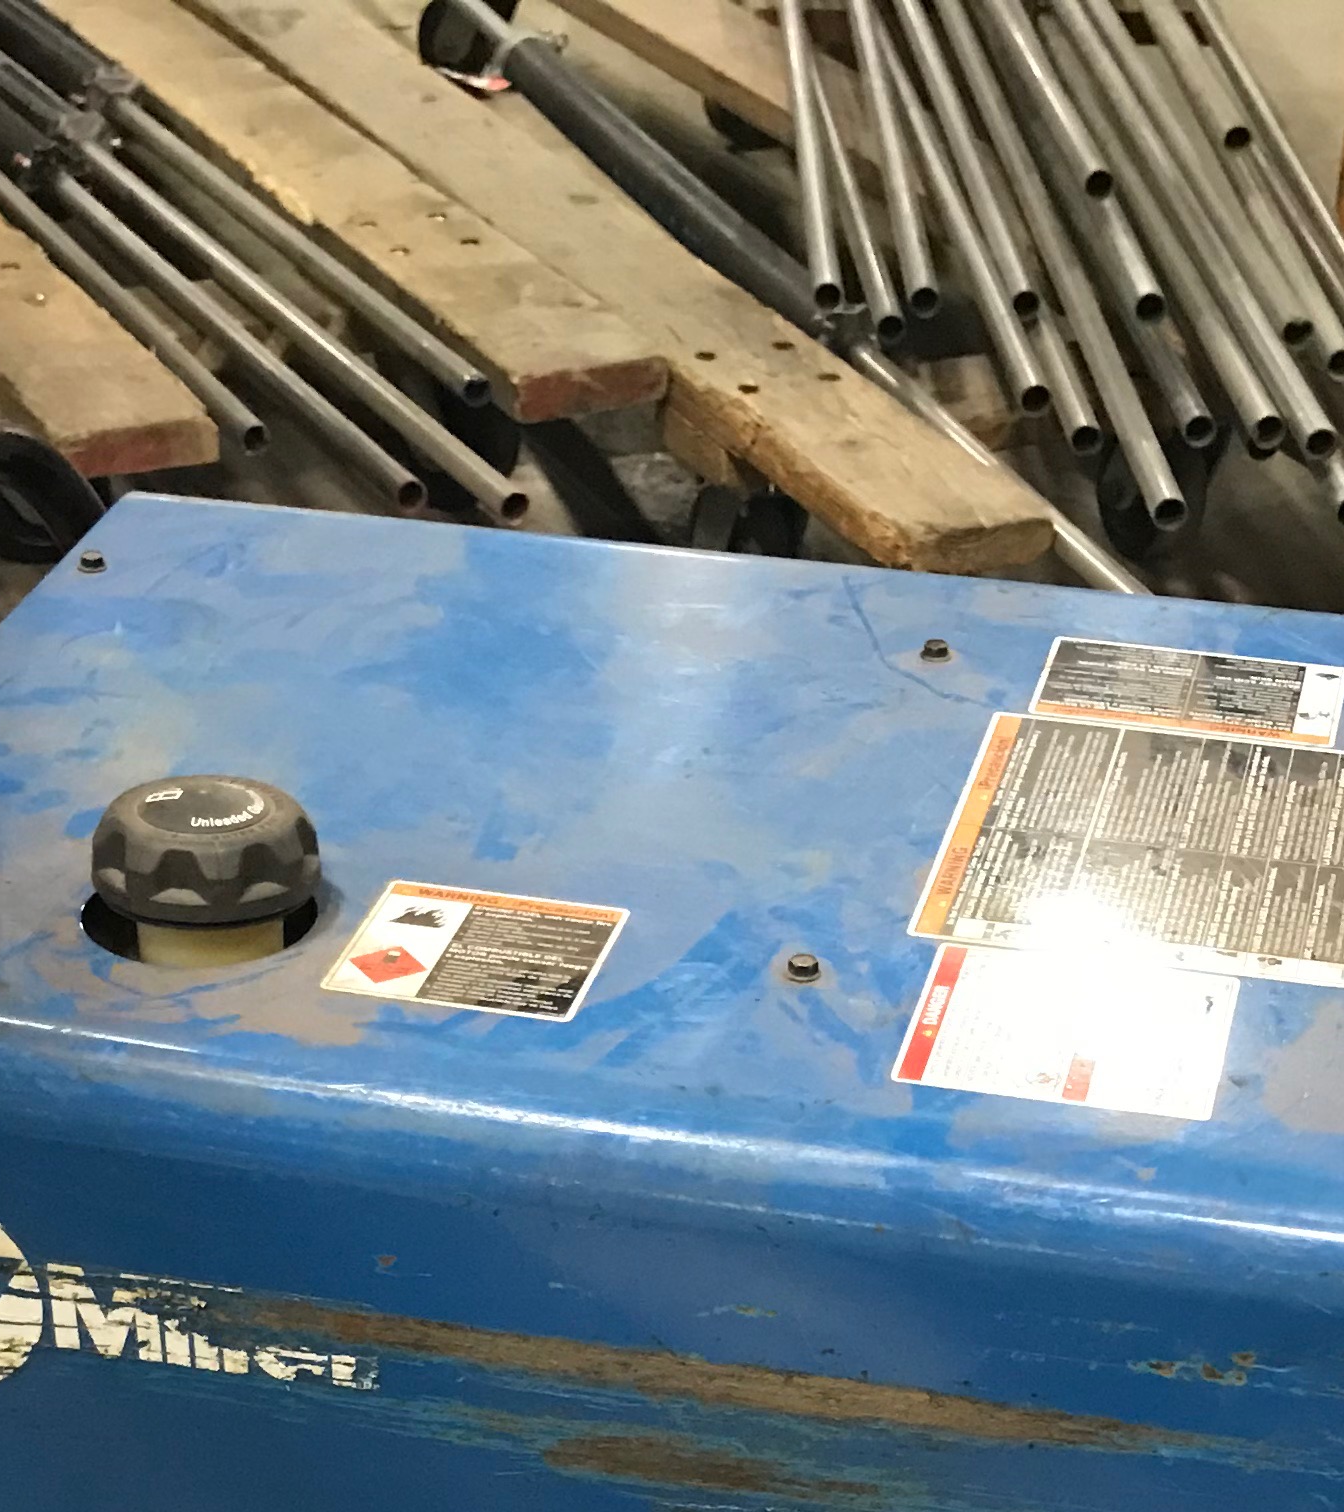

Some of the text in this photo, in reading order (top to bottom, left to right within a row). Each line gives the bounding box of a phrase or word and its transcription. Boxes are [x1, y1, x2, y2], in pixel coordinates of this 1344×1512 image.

[190, 809, 252, 828] Unleaded
[934, 846, 968, 895] WARNING
[417, 888, 500, 904] WARNING
[920, 984, 950, 1025] DANGER
